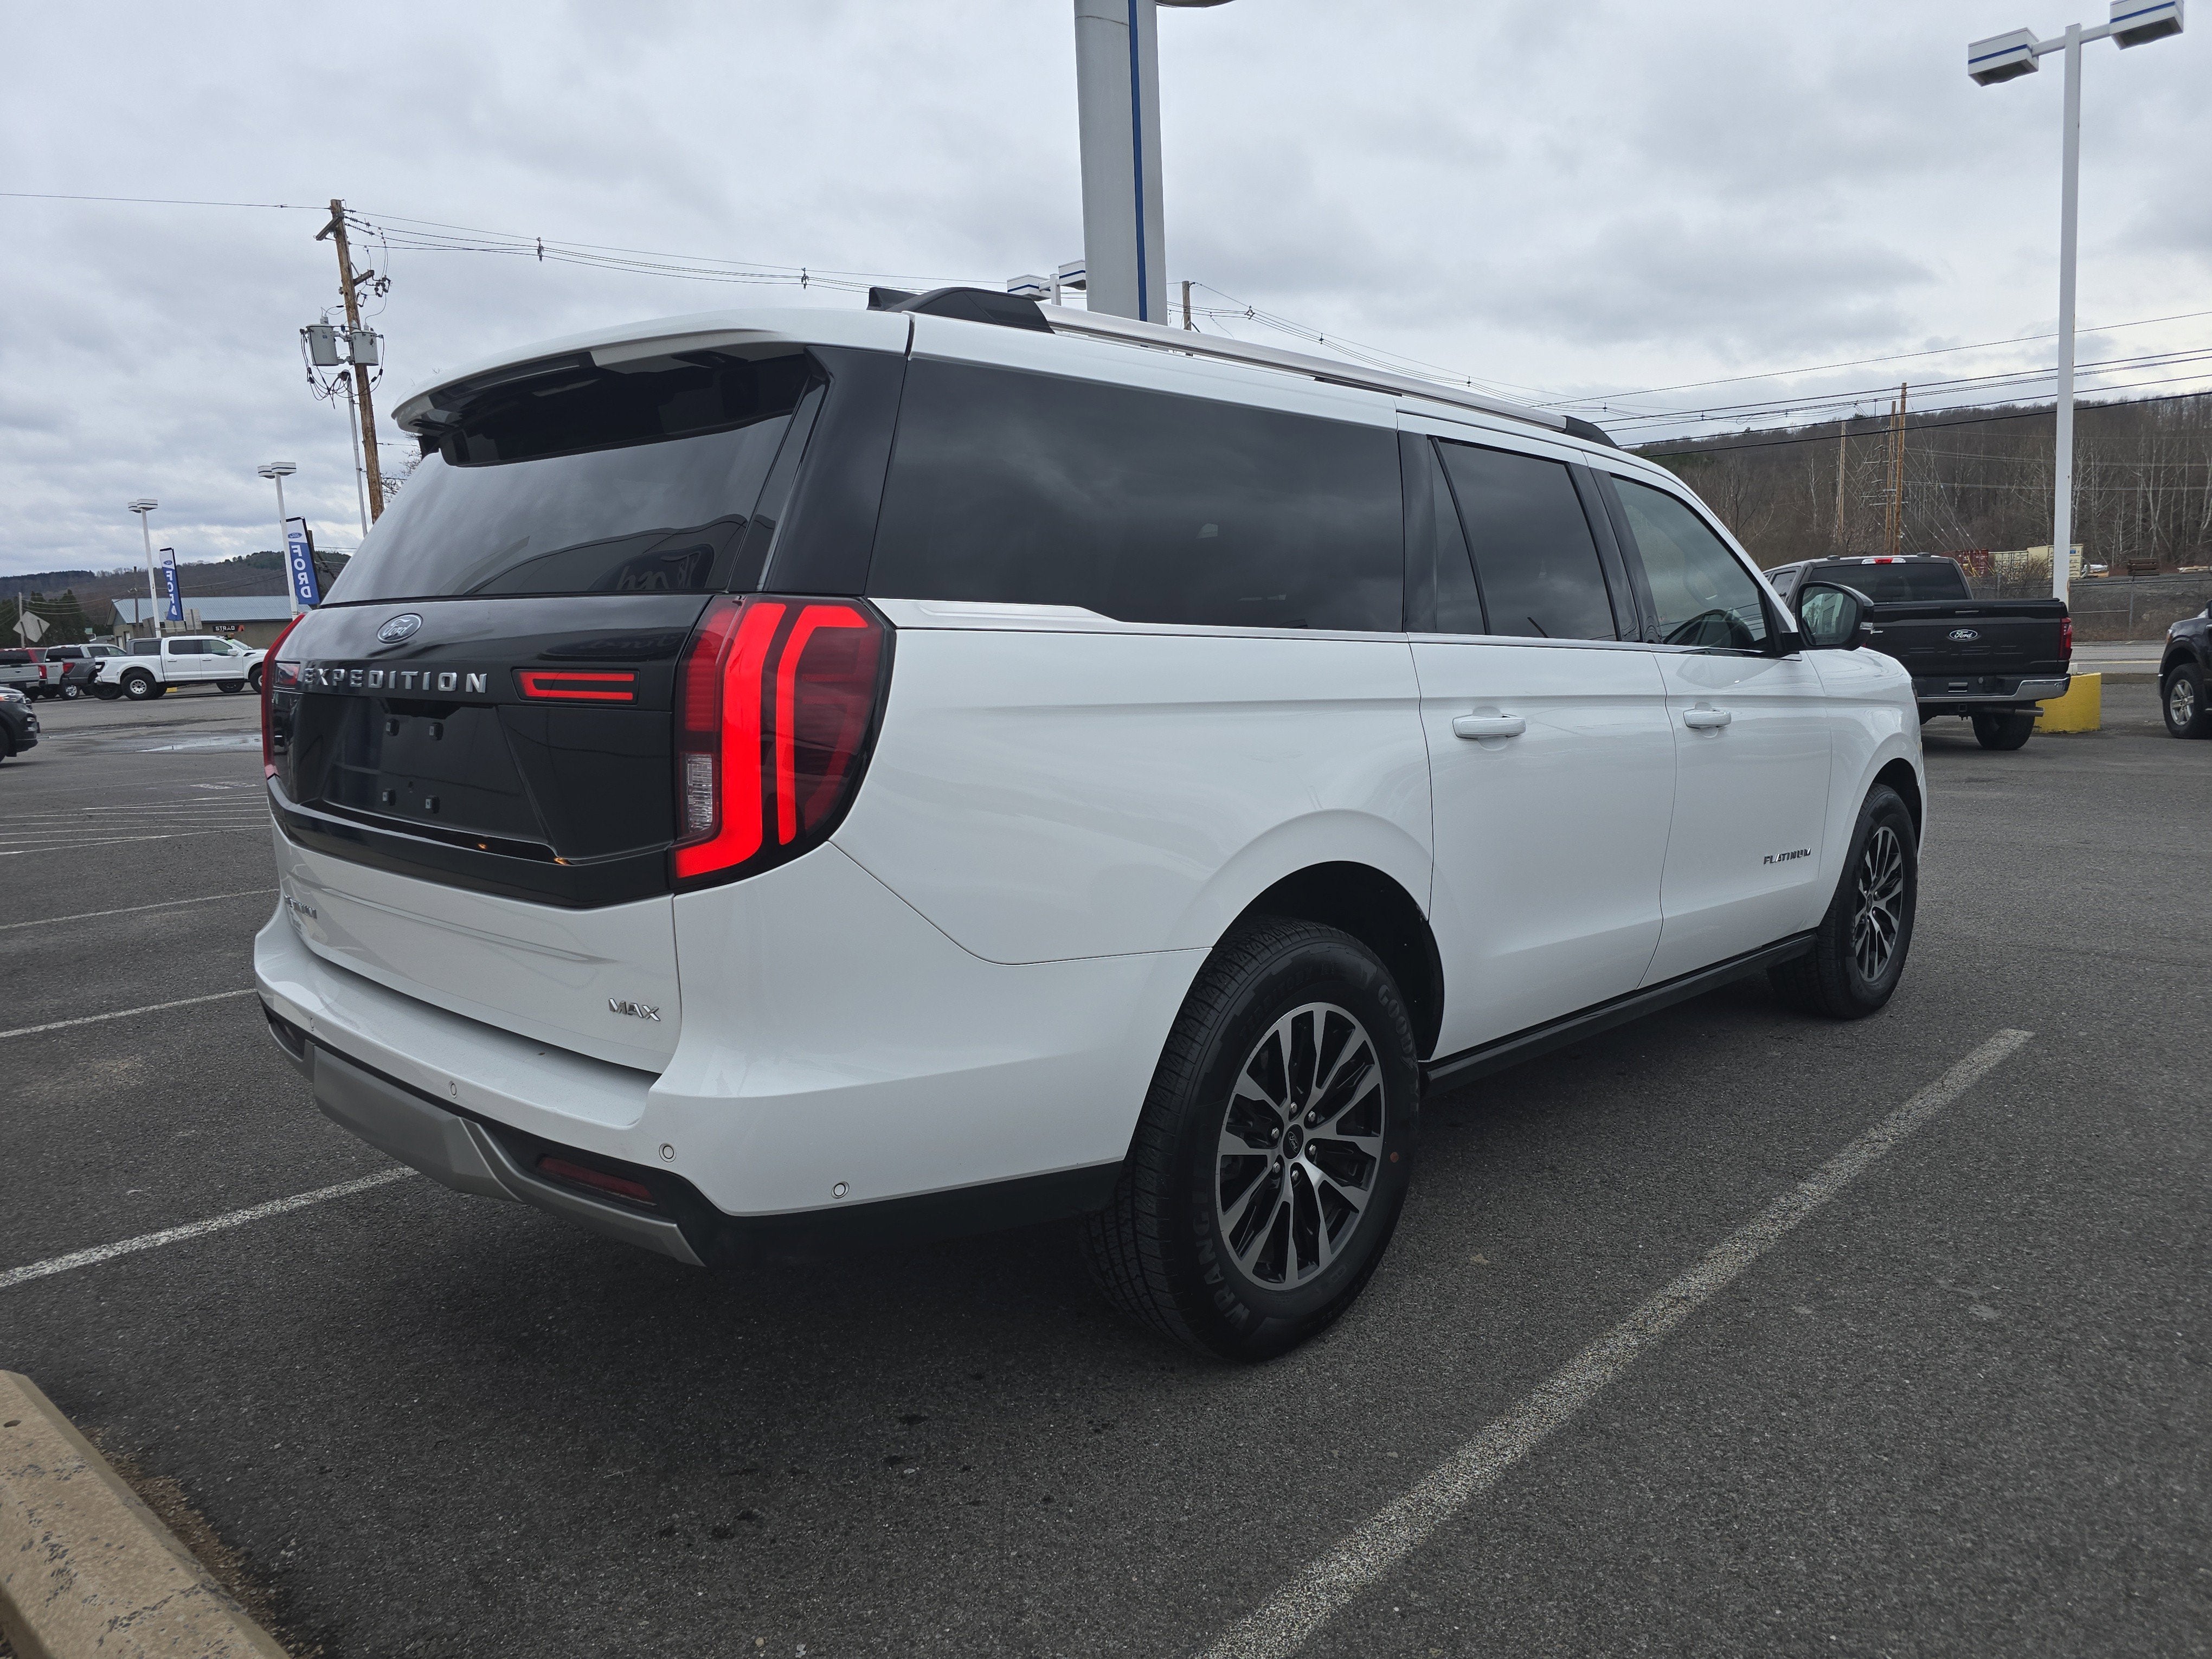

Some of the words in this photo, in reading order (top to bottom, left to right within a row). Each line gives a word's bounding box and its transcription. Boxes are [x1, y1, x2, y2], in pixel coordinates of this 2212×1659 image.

[382, 618, 414, 636] Ford
[1954, 630, 1973, 639] Ford
[304, 668, 487, 694] EXPEDITION
[1763, 847, 1812, 865] PLATINUM
[608, 998, 661, 1021] MAX
[1289, 1135, 1298, 1150] Ford
[1191, 1123, 1250, 1330] WRANGLE
